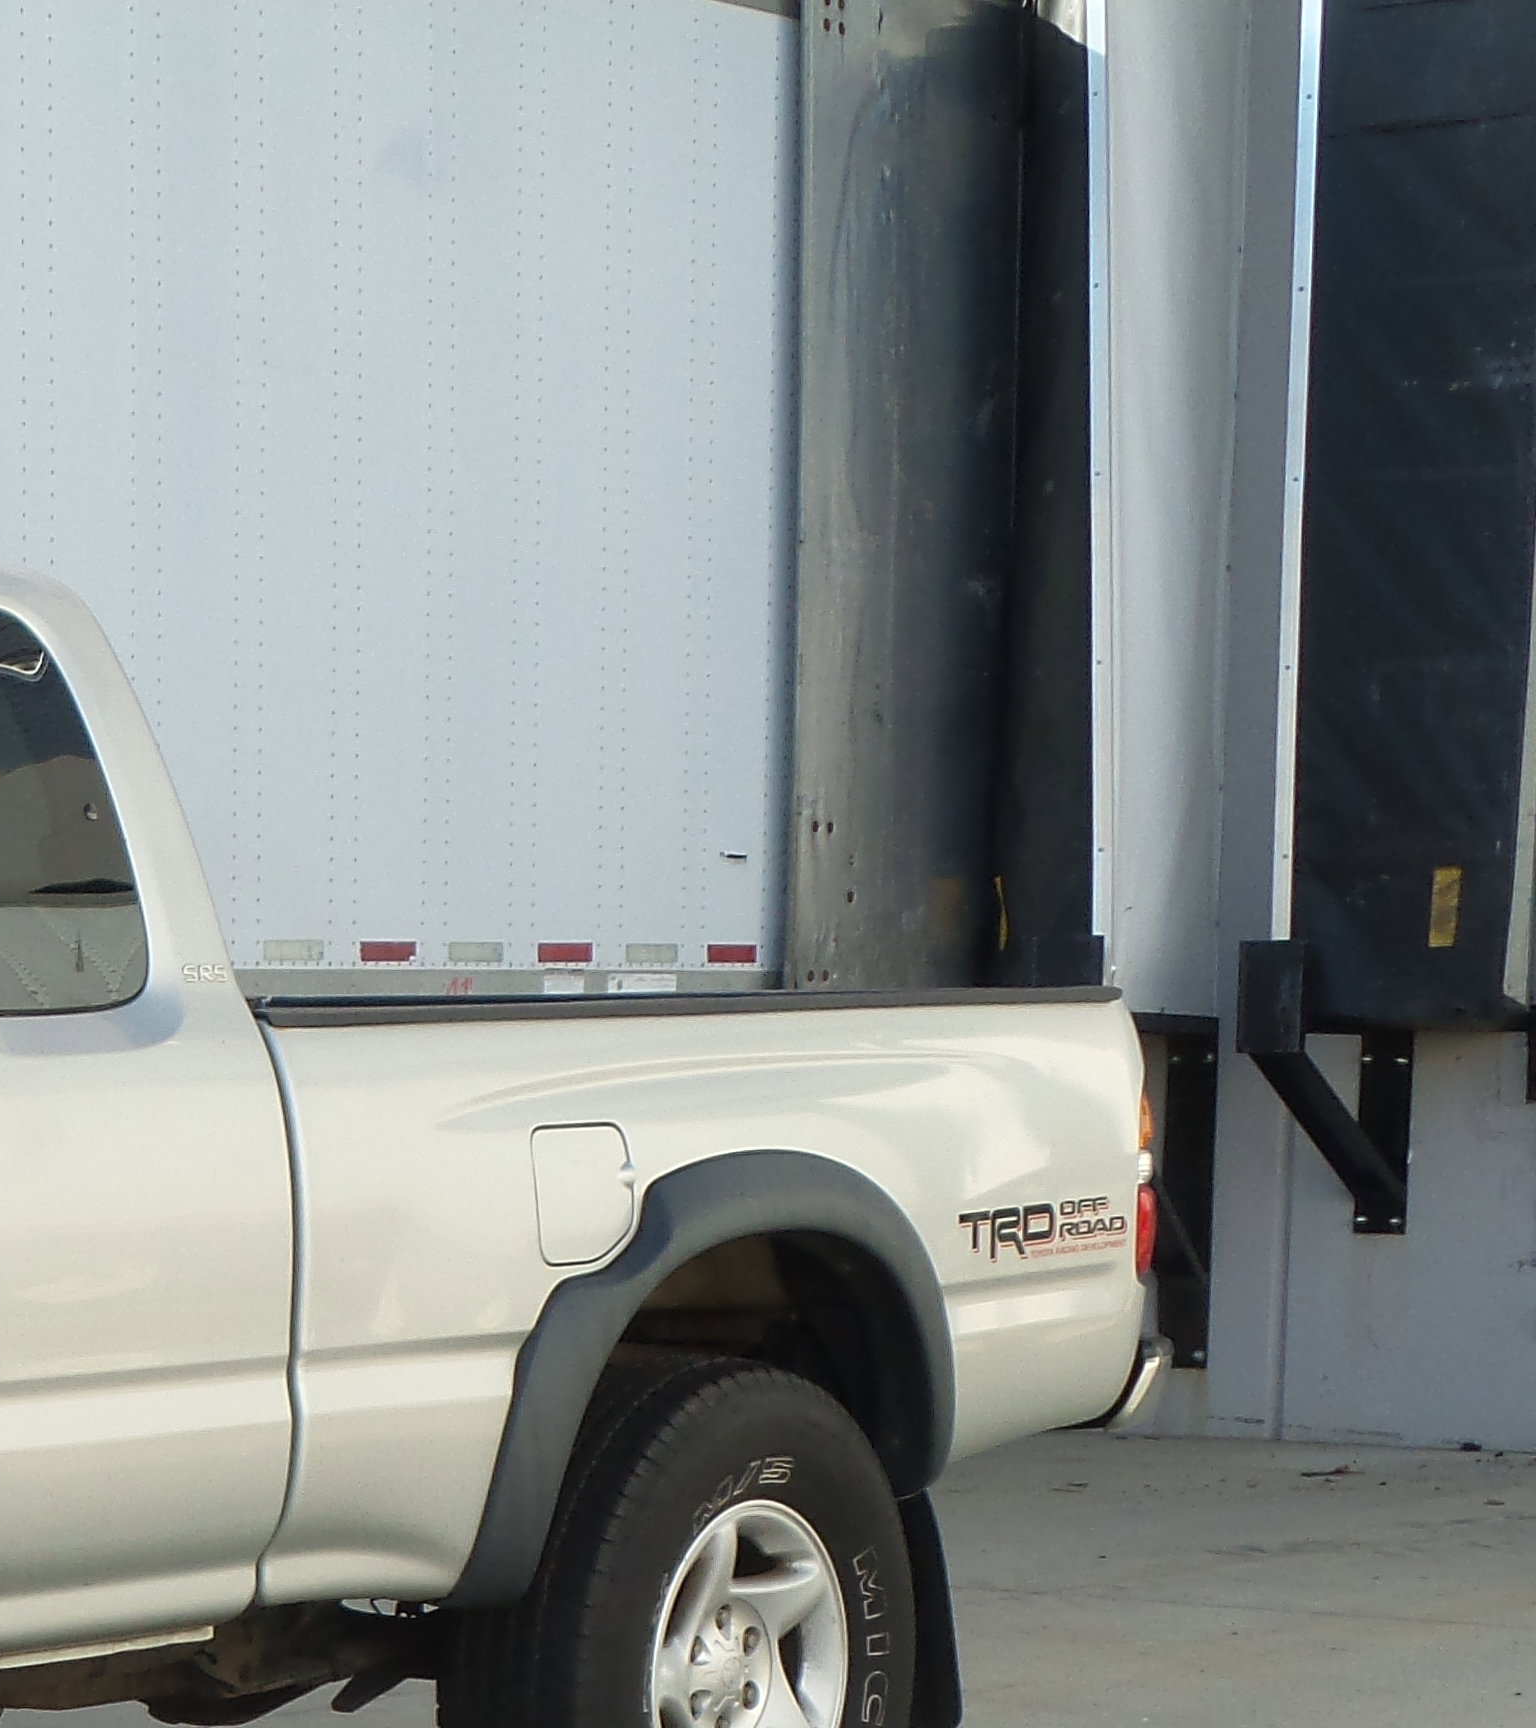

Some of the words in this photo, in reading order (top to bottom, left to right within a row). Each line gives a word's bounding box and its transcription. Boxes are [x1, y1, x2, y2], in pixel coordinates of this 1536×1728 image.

[1059, 1196, 1109, 1219] OFF
[958, 1202, 1056, 1263] TRD
[1059, 1216, 1127, 1241] ROAD
